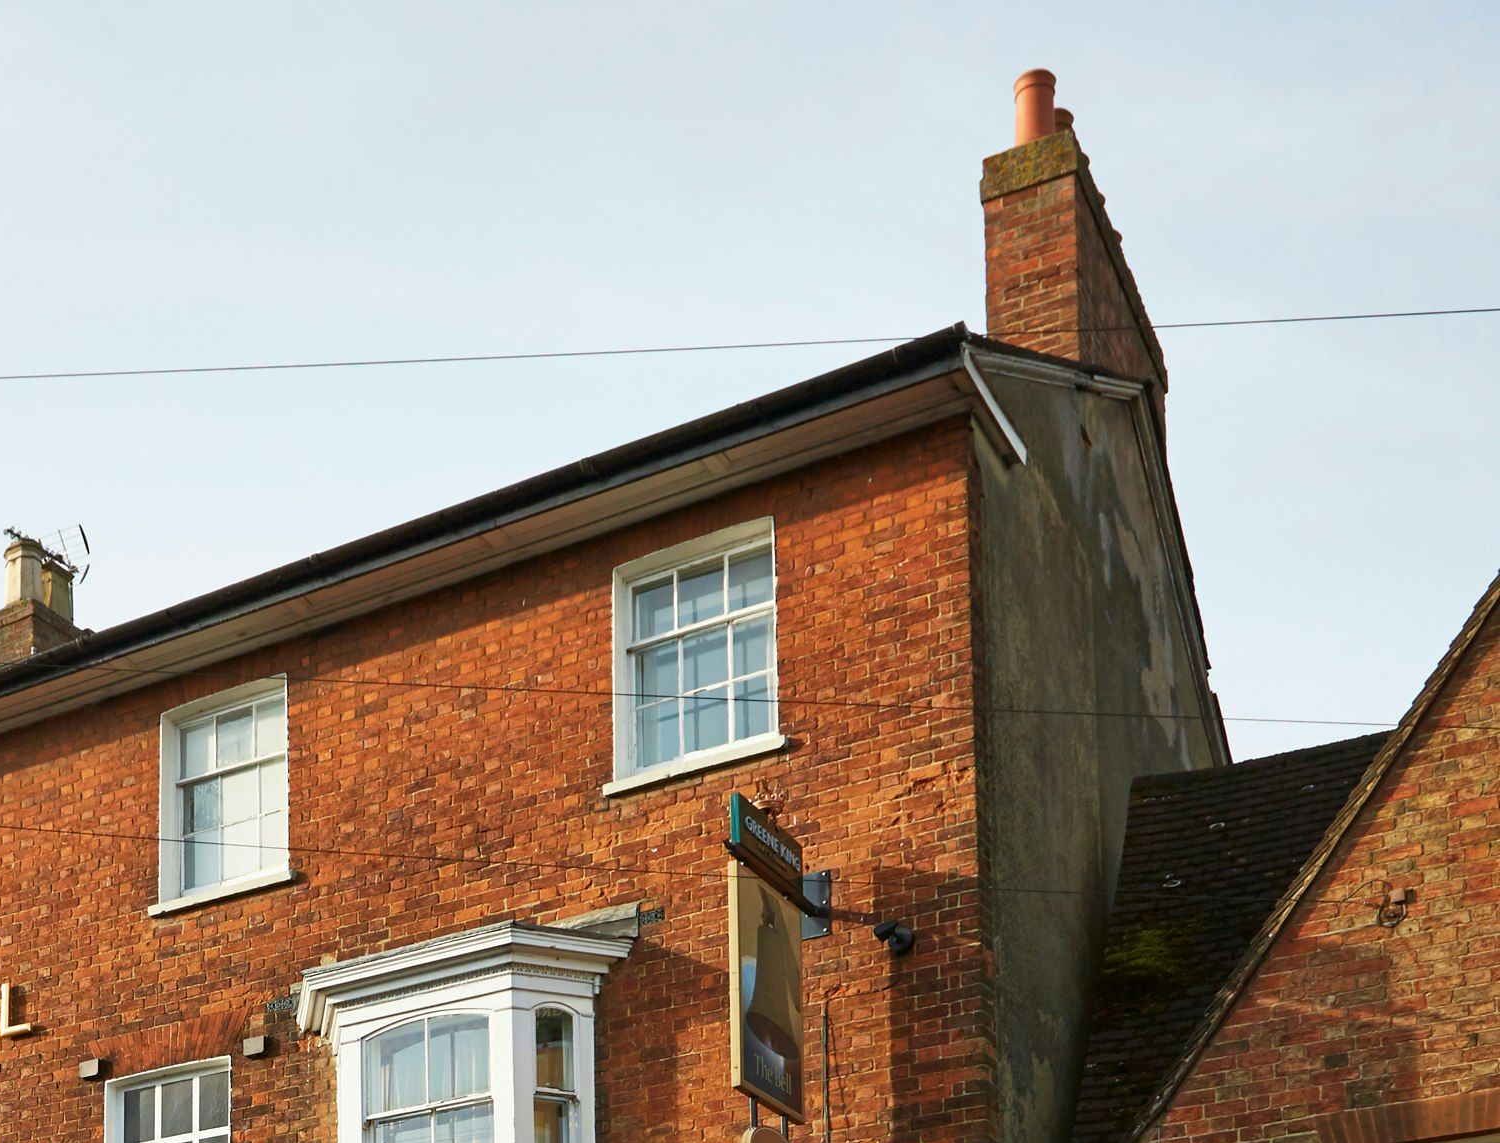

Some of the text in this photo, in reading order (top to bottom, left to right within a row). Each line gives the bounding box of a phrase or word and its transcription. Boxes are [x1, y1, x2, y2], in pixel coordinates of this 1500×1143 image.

[745, 816, 779, 853] GREENE
[780, 843, 801, 872] KING
[754, 1053, 792, 1096] The Bell
